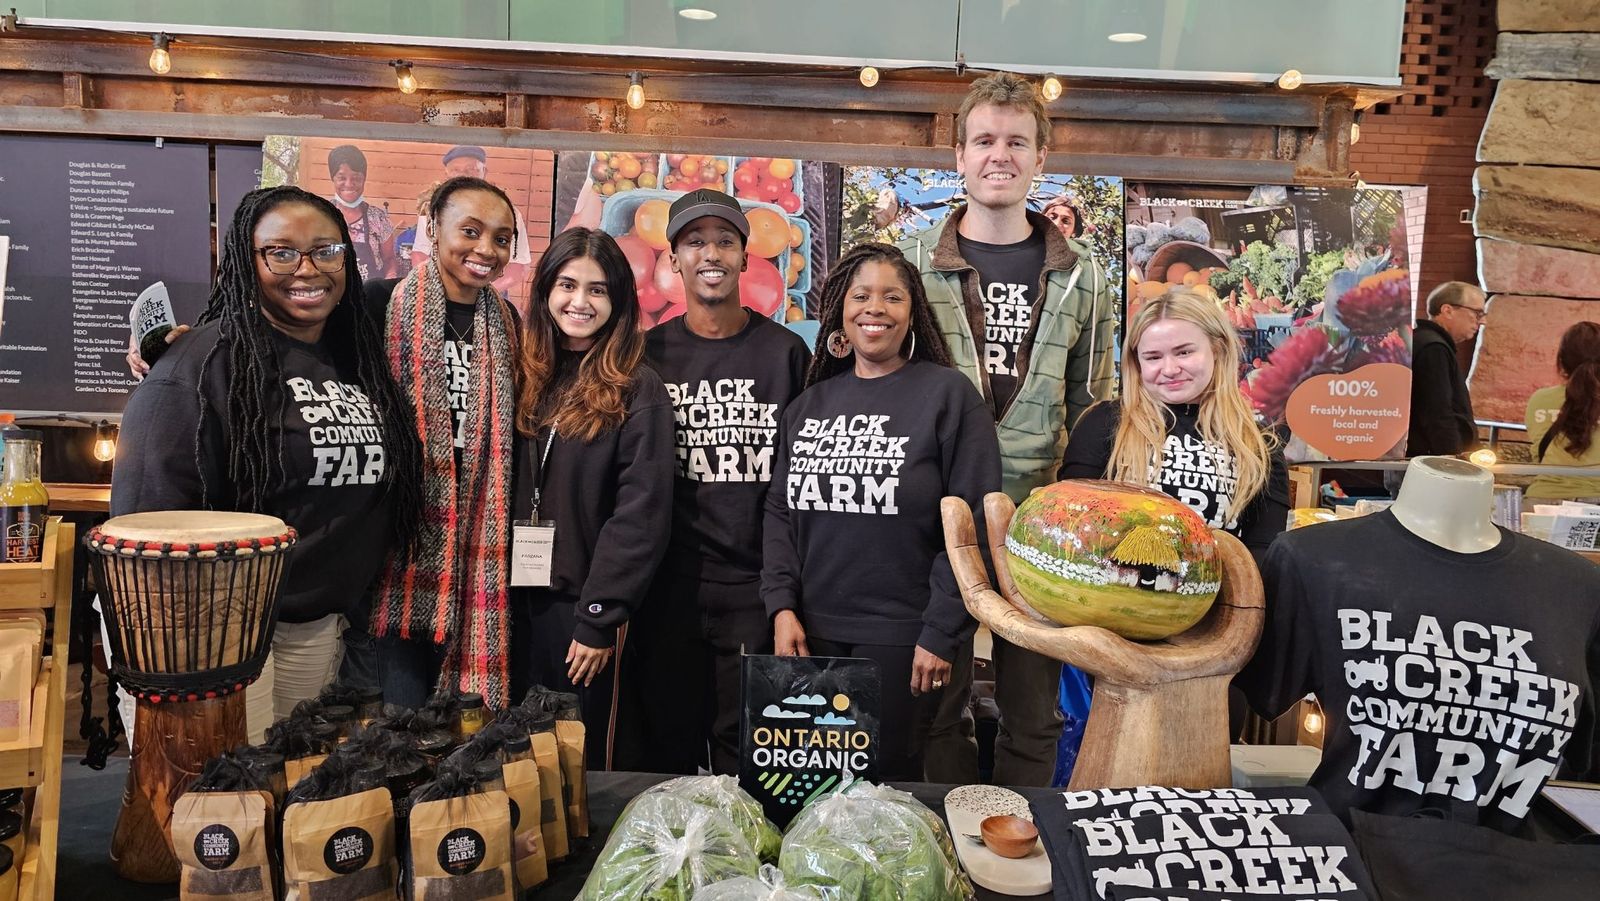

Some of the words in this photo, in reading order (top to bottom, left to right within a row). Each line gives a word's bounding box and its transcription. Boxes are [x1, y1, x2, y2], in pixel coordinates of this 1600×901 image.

[1139, 198, 1176, 206] BLACK
[1188, 199, 1224, 208] CREEK
[984, 303, 1031, 328] REE
[286, 377, 369, 404] BLACK
[664, 379, 755, 406] BLACK
[1328, 379, 1378, 397] 100%
[330, 401, 383, 424] CRE
[688, 403, 778, 428] CREEK
[1310, 405, 1347, 417] Freshly
[1349, 405, 1402, 418] harvested,
[310, 426, 383, 445] COMMU
[798, 414, 890, 439] BLACK
[1333, 419, 1356, 429] local
[1359, 419, 1378, 430] and
[676, 427, 777, 446] OMMUNITY
[814, 435, 910, 458] CREEK
[1336, 433, 1374, 443] organic
[308, 445, 385, 487] FAR
[788, 457, 905, 476] COMMUNITY
[787, 474, 900, 515] FARM
[1583, 522, 1599, 548] FARM
[6, 545, 39, 557] HEAT
[1337, 608, 1537, 673] BLACK
[1395, 653, 1580, 728] CREEK
[1346, 694, 1573, 759] COMMUNITY
[754, 727, 870, 750] ONTARIO
[753, 748, 869, 770] ORGANIC
[1347, 723, 1556, 819] FARM
[334, 834, 356, 845] BLACK
[447, 836, 469, 845] BLACK
[1080, 813, 1292, 857] BLACK
[204, 848, 230, 856] FARM
[336, 848, 364, 862] FARM
[448, 850, 475, 862] FARM
[1154, 845, 1358, 895] CREEK
